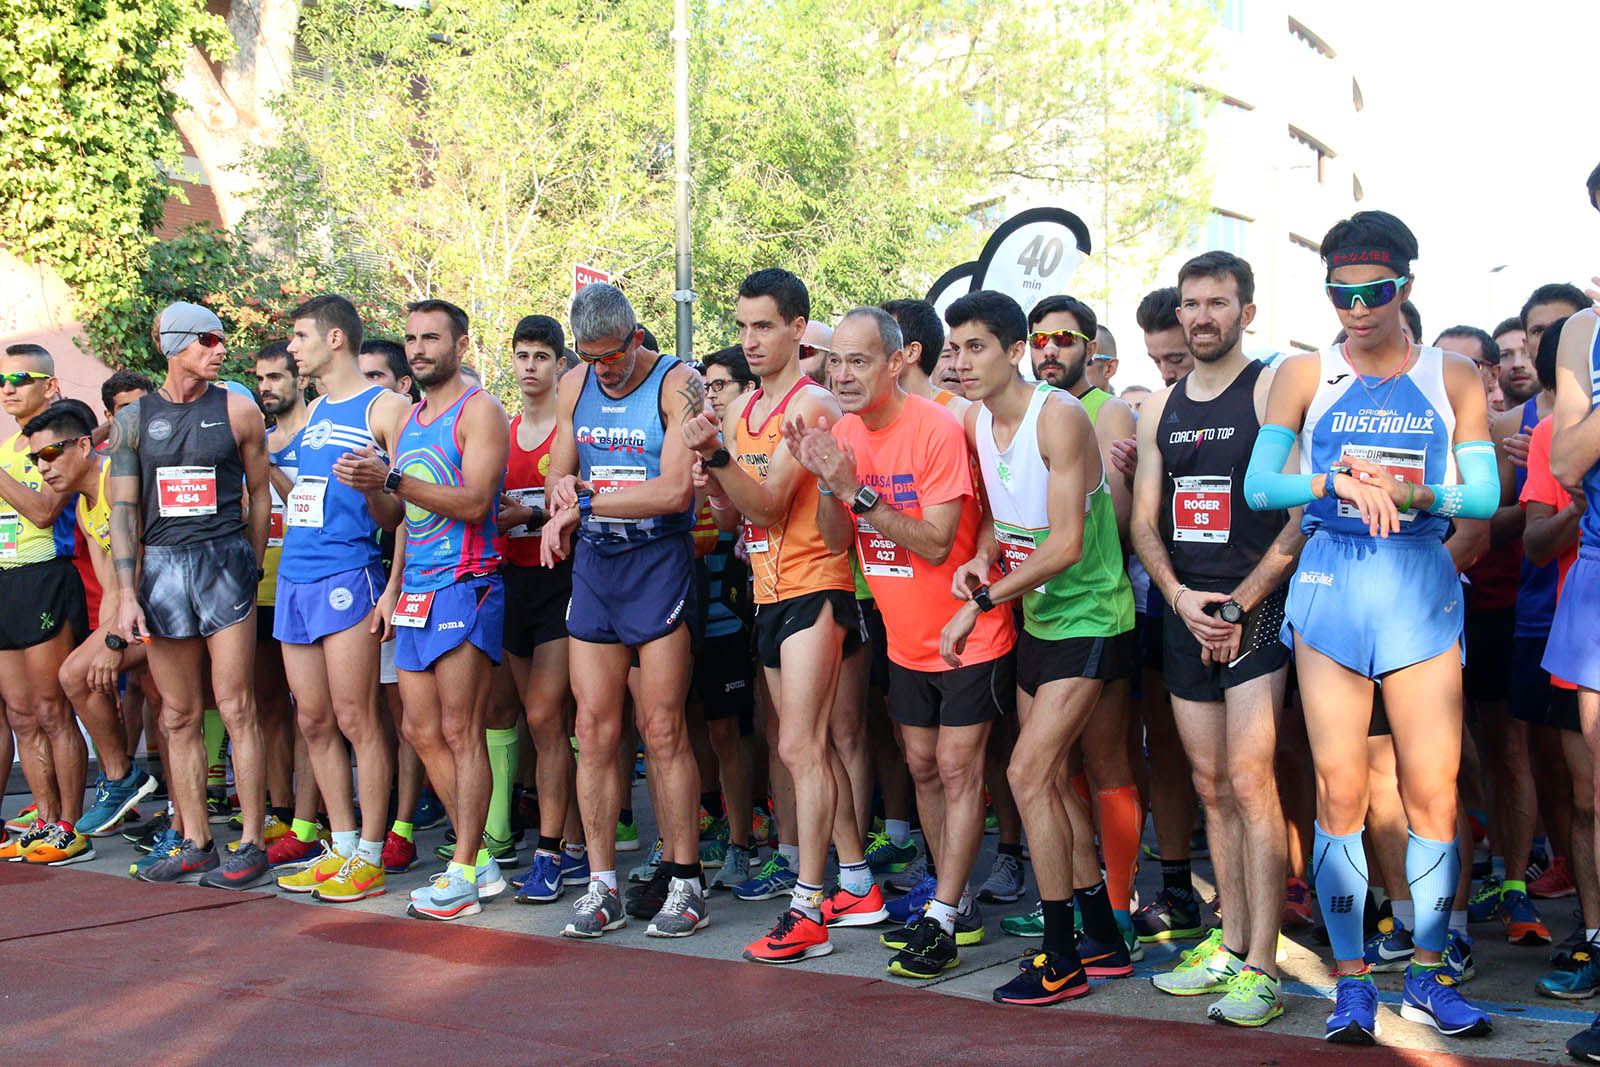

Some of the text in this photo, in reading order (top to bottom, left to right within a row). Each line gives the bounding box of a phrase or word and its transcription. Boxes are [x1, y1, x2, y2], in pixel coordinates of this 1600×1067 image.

[1017, 234, 1063, 278] 40
[1022, 279, 1042, 290] min
[1203, 428, 1216, 441] TO
[1217, 427, 1235, 440] TOP
[599, 435, 644, 447] esportiu
[167, 484, 208, 493] MATTIAS
[175, 493, 200, 504] 454
[294, 504, 310, 512] 1120
[1184, 500, 1220, 511] ROGER
[1193, 512, 1210, 525] 85
[869, 539, 897, 549] JOSEP
[876, 550, 896, 561] 427
[406, 593, 427, 602] OSCAR
